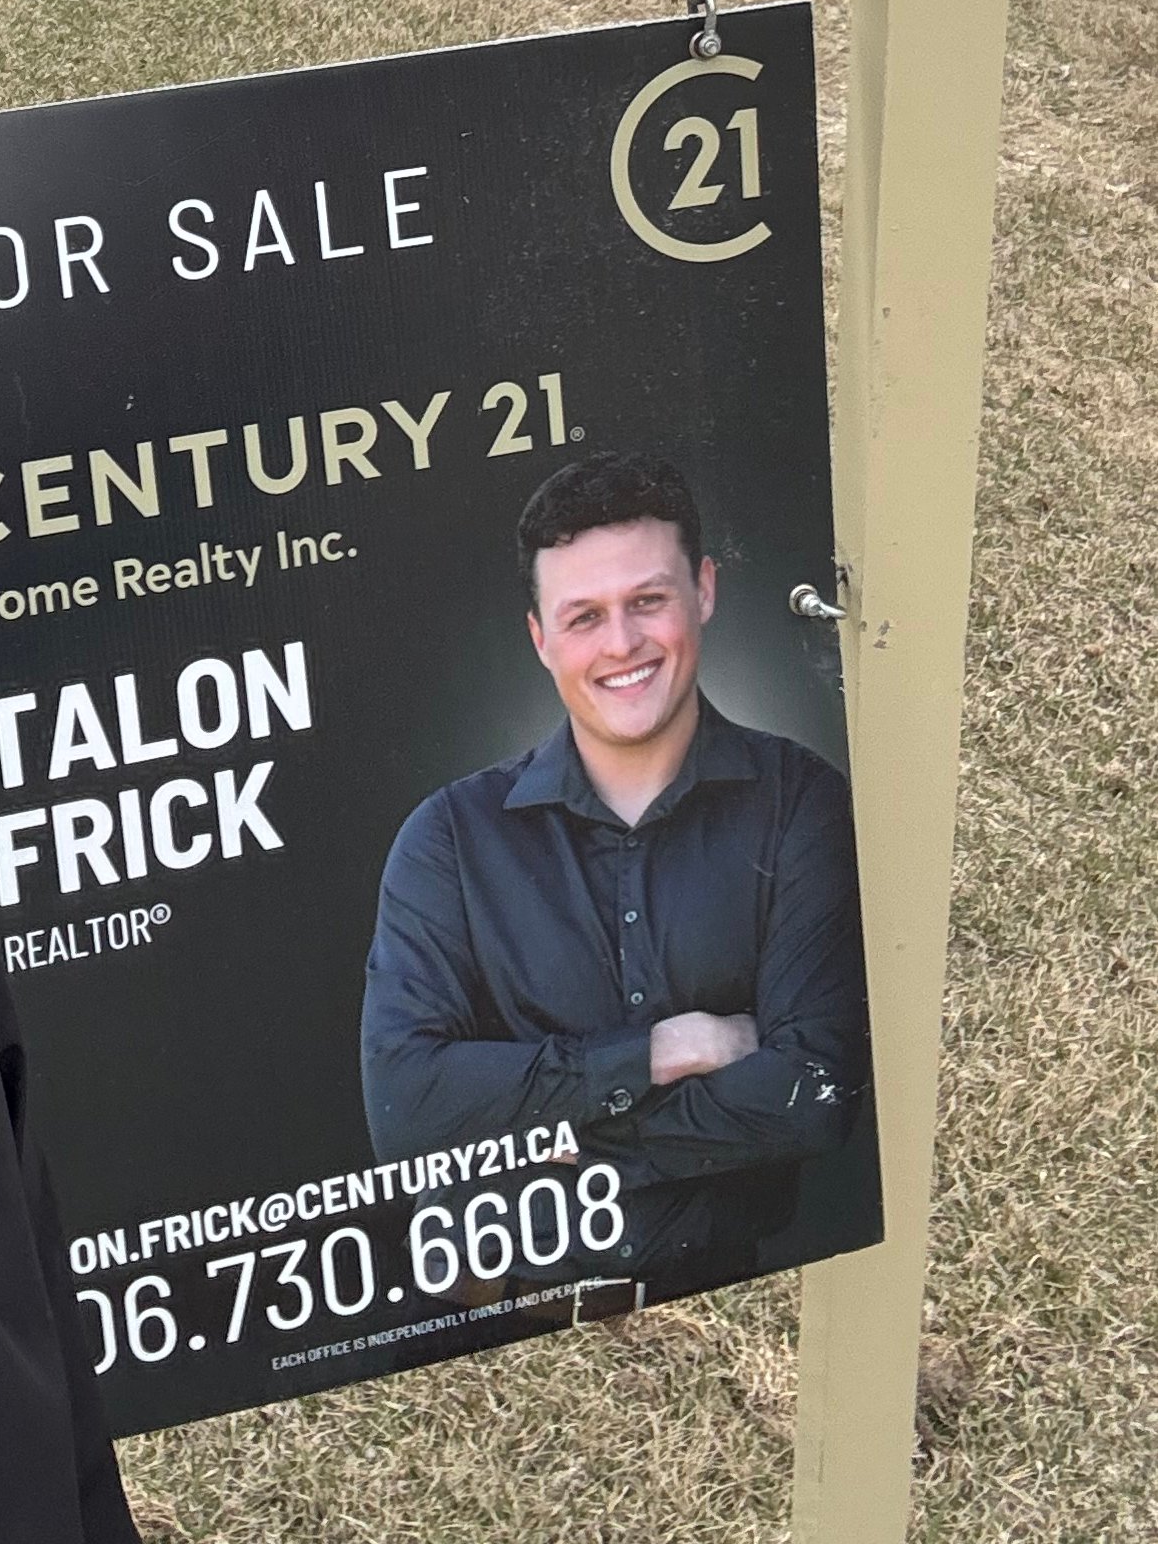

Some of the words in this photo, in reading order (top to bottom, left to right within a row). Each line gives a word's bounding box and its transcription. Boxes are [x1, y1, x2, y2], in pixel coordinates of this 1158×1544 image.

[170, 166, 434, 281] SALE
[114, 543, 263, 600] Realty
[278, 528, 359, 570] Inc.
[271, 1351, 307, 1371] EACH
[308, 1340, 352, 1362] OFFICE
[353, 1336, 367, 1351] IS
[368, 1309, 467, 1347] INDEPENDENTLY
[469, 1299, 513, 1322] OWNED
[514, 1292, 540, 1309] AND
